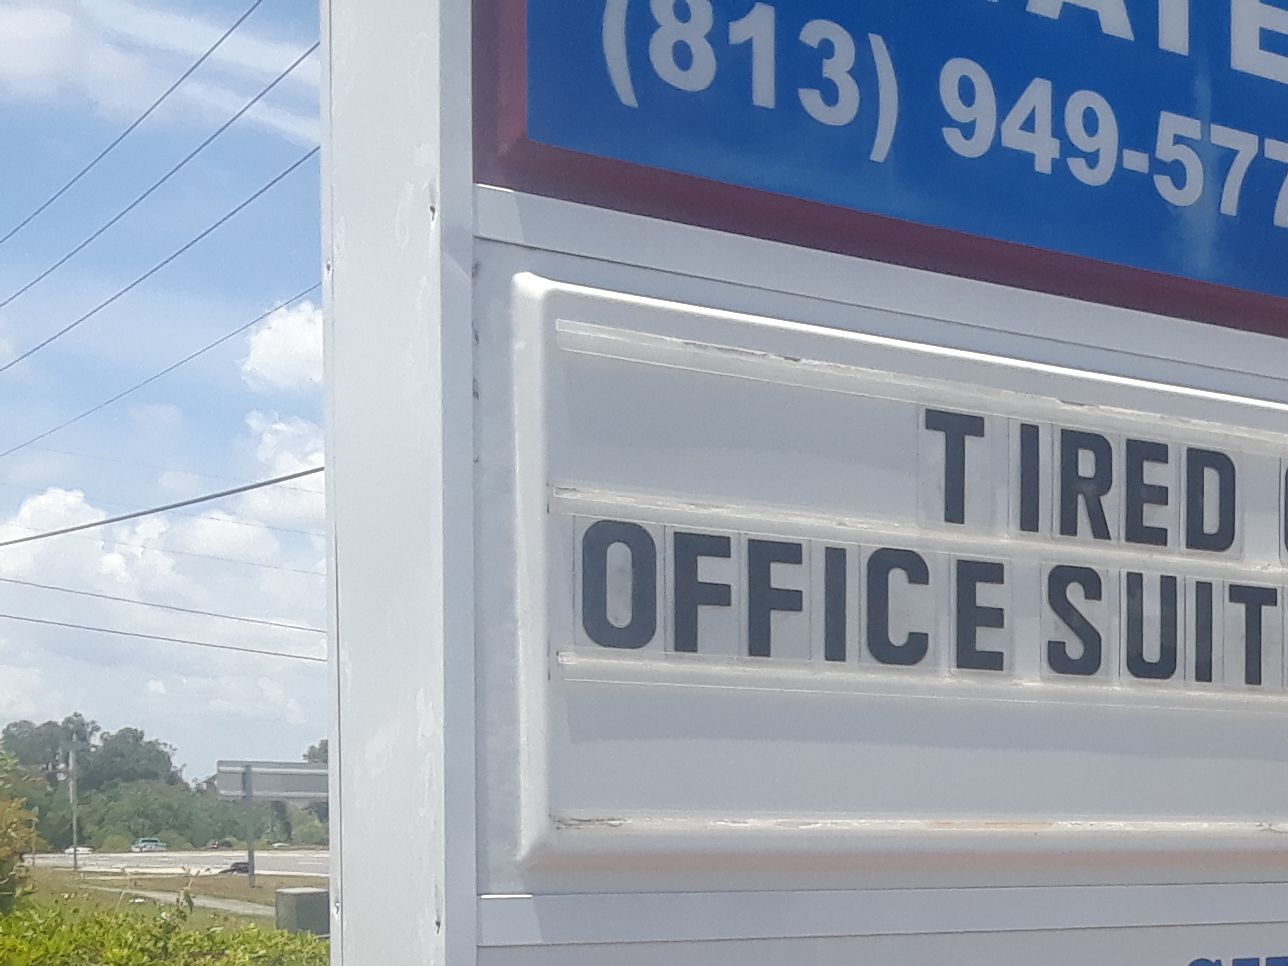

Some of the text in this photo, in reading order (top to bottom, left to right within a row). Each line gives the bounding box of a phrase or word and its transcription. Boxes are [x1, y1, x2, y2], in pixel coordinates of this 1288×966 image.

[602, 0, 899, 163] (813)
[924, 408, 1237, 555] TIRED
[581, 518, 1005, 672] OFFICE
